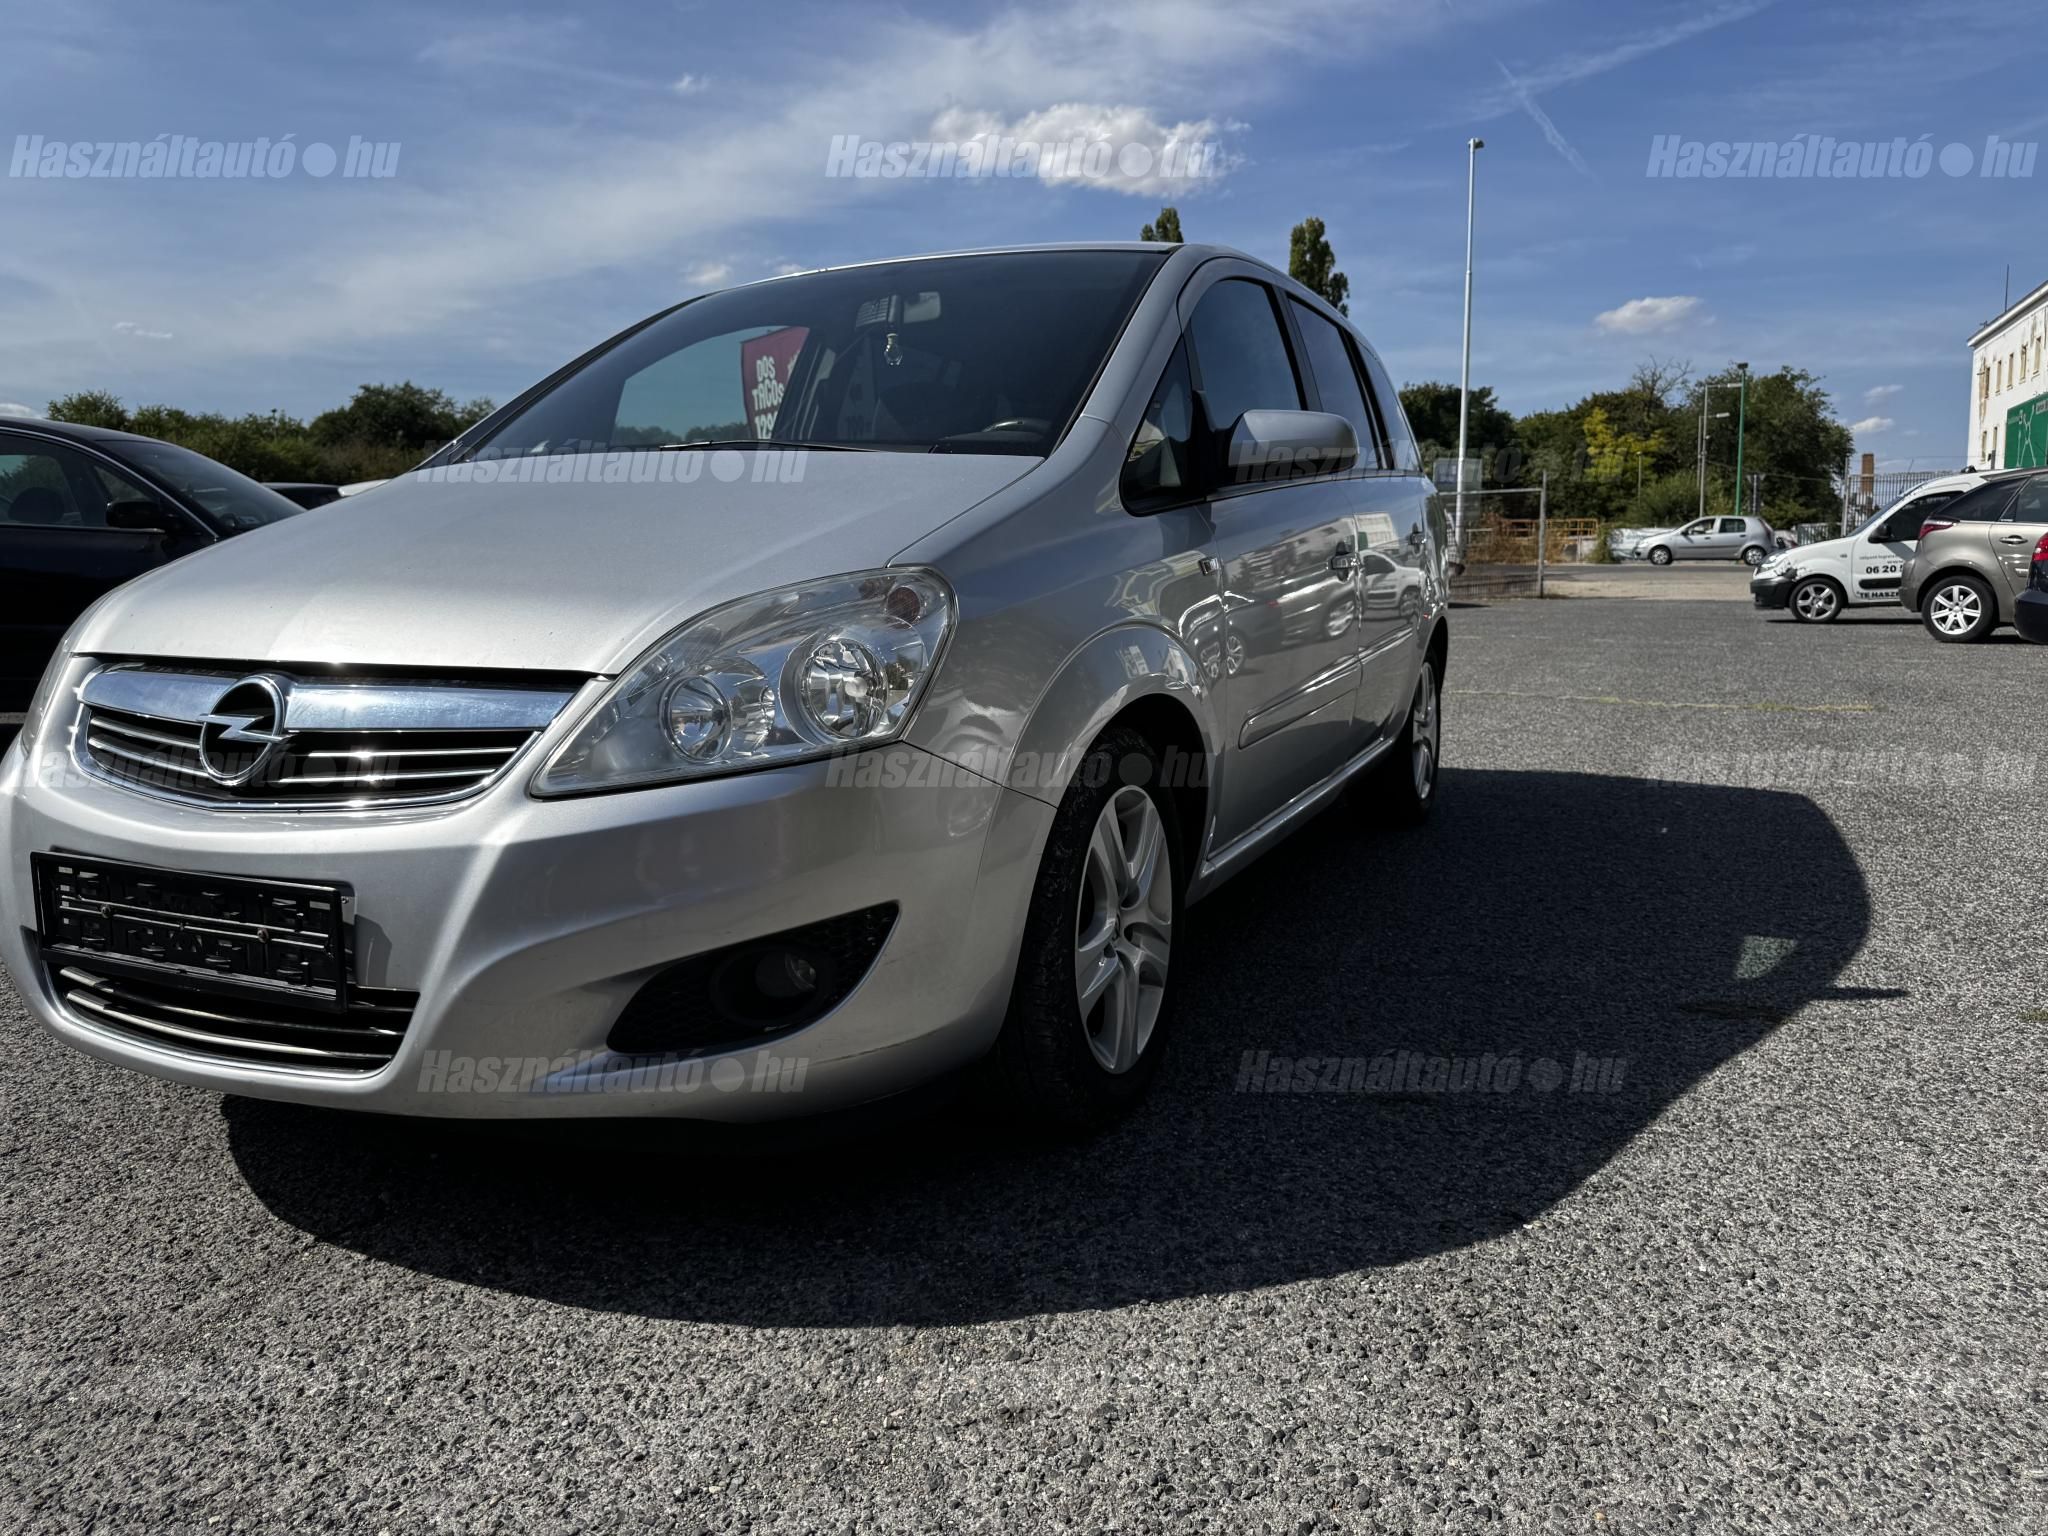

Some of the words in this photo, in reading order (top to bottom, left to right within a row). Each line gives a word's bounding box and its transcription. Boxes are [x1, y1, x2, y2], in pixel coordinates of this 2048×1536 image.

[756, 355, 775, 382] DOS
[752, 380, 785, 411] TACOS
[1865, 566, 1880, 575] 06
[1882, 565, 1897, 574] 20
